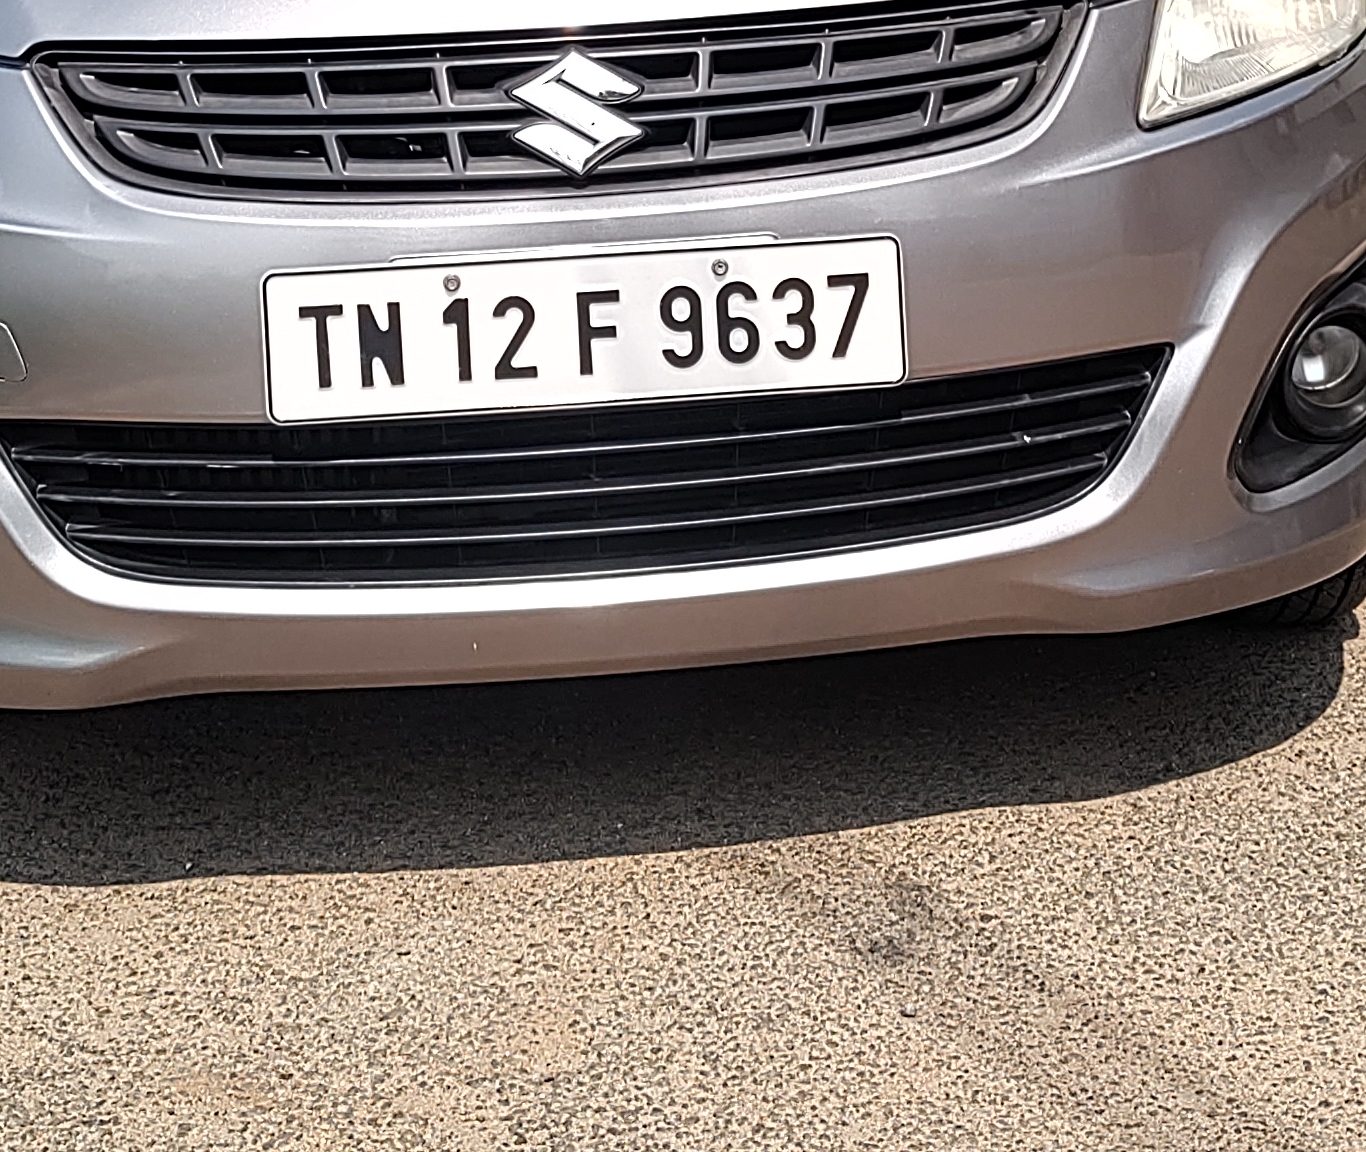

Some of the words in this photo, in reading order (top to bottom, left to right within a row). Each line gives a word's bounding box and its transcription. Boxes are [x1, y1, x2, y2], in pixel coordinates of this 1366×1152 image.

[299, 300, 405, 389] TN
[443, 296, 538, 382] 12
[576, 290, 621, 376] F
[660, 273, 869, 369] 9637
